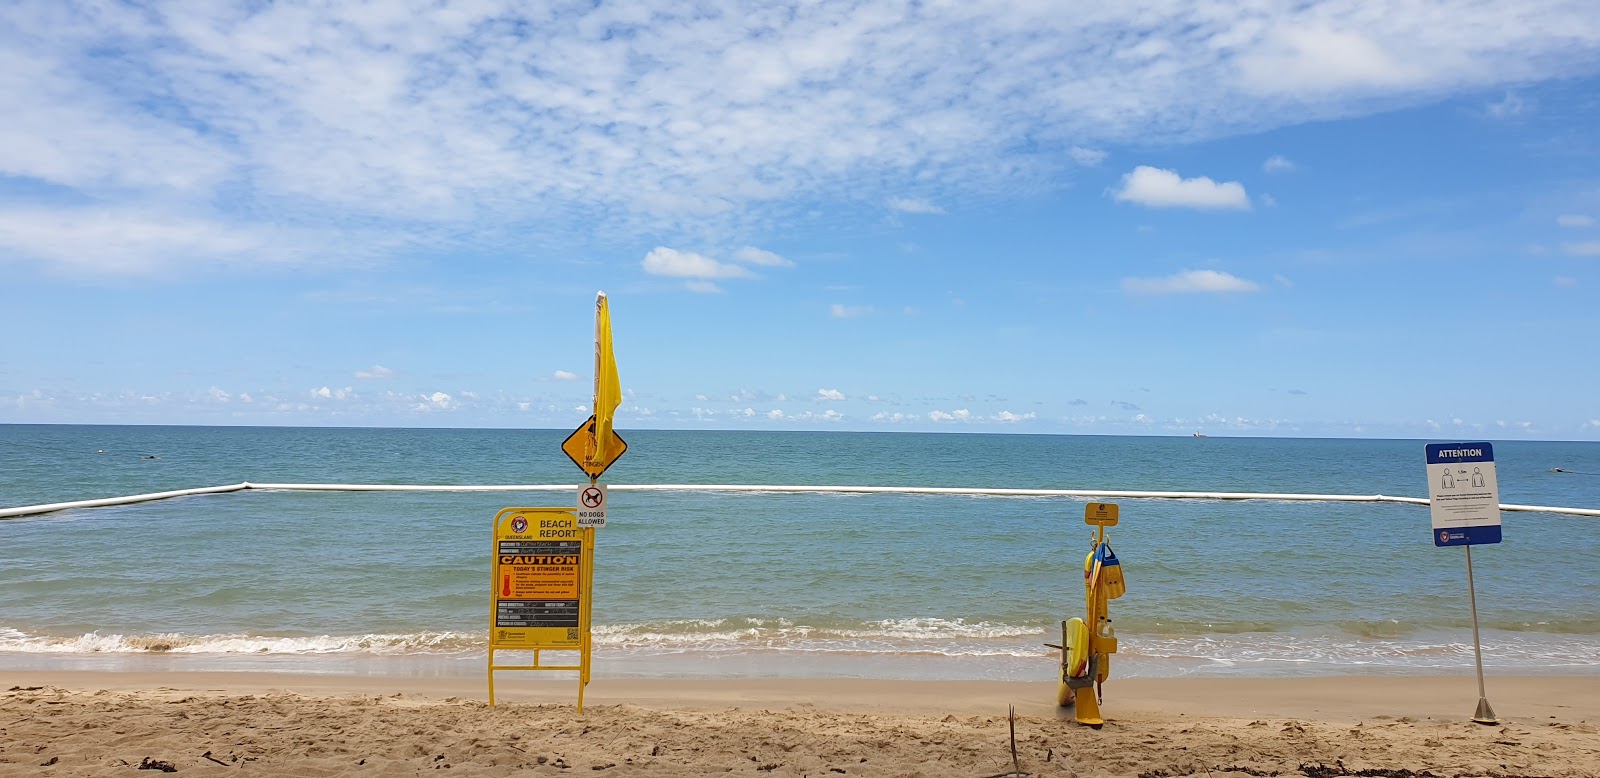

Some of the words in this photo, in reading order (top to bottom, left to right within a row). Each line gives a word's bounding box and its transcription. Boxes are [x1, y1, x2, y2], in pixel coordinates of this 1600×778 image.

[1439, 449, 1482, 458] ATTENTION
[540, 520, 572, 528] BEACH
[540, 530, 577, 538] REPORT
[501, 556, 577, 564] CAUTION
